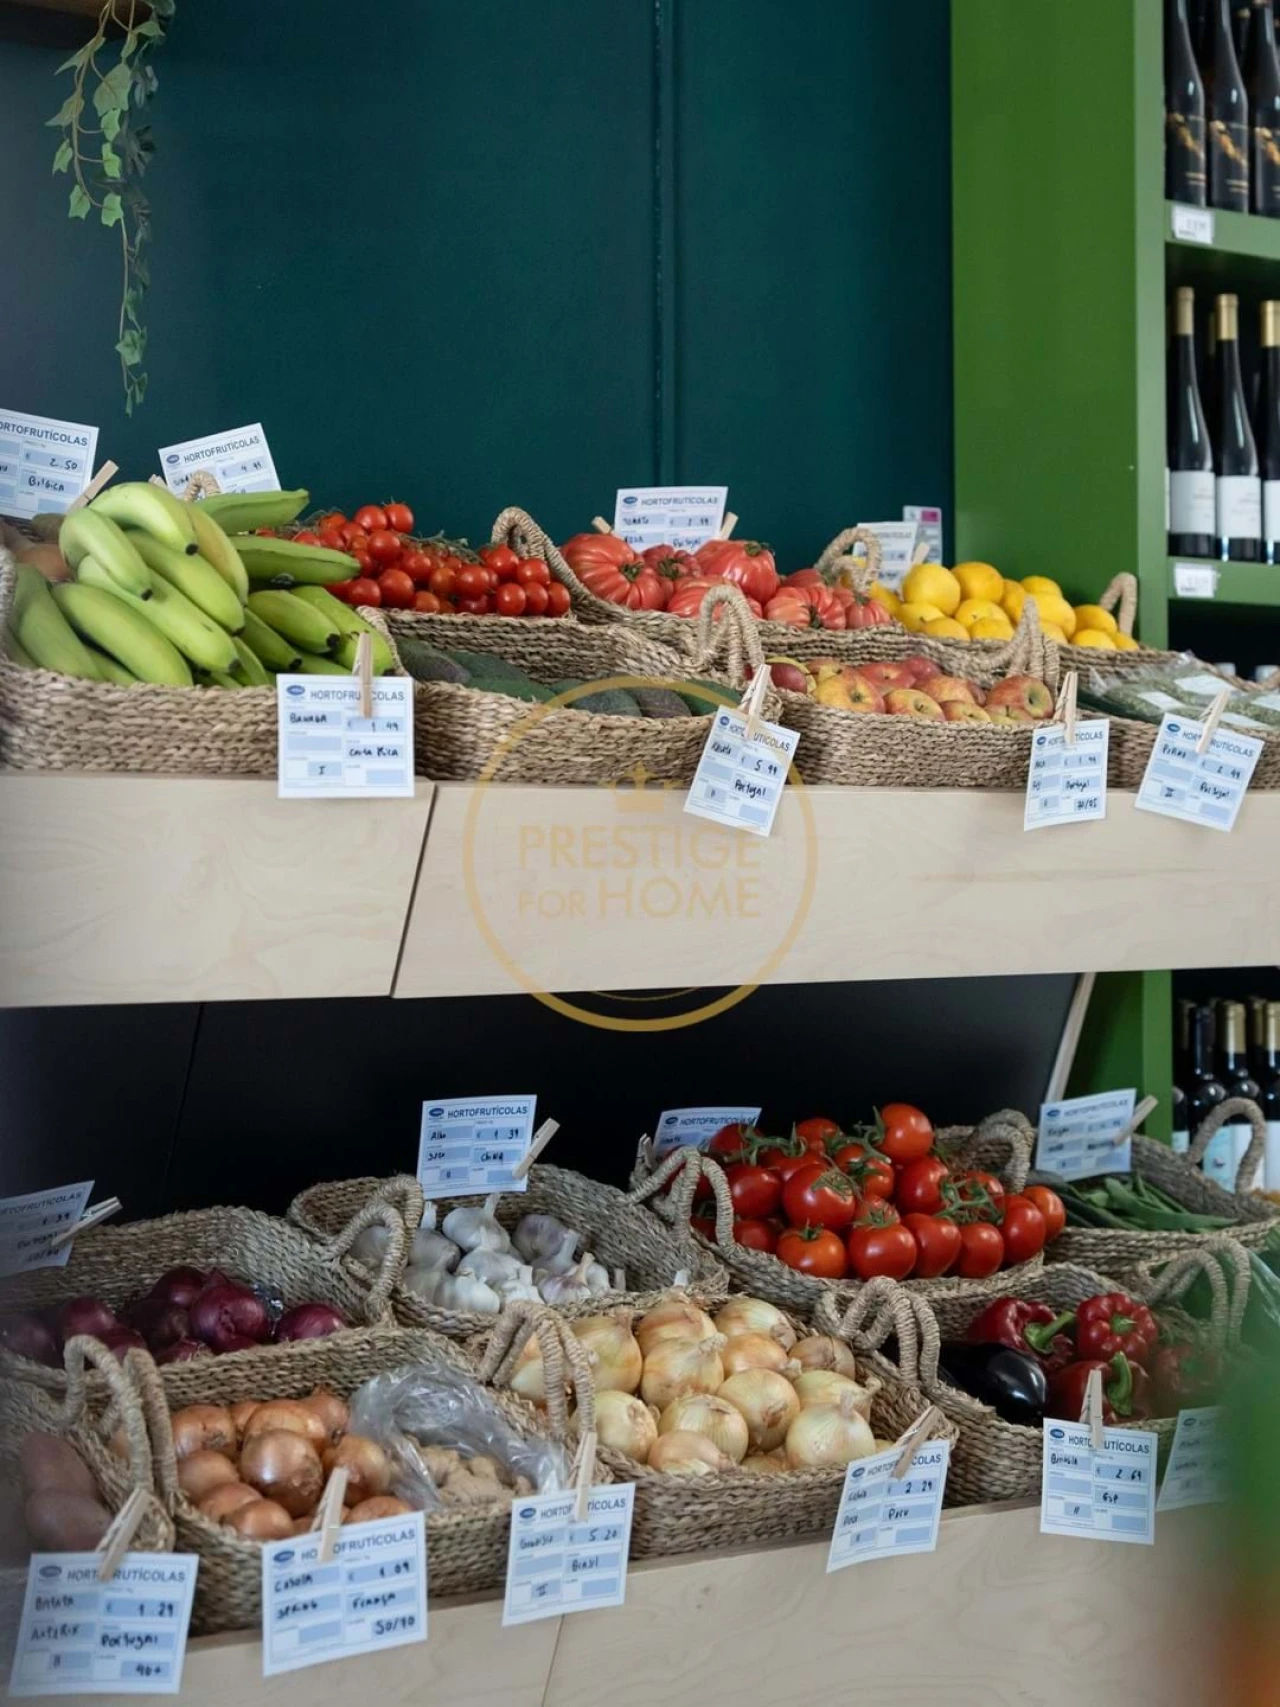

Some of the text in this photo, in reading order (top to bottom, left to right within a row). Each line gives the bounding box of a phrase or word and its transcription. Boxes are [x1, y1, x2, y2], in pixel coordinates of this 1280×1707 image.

[0, 421, 88, 447] RTOFRUTÍCOLAS
[183, 435, 260, 463] HORTOFRUTÍCOLAS
[310, 689, 405, 701] HORTOFRUCOLAS
[447, 1105, 528, 1118] HORTOFRUTÍCOLAS
[300, 1528, 416, 1561] HOOFRUTÍCOLAS
[67, 1569, 186, 1582] HORTRUTÍCOLAS
